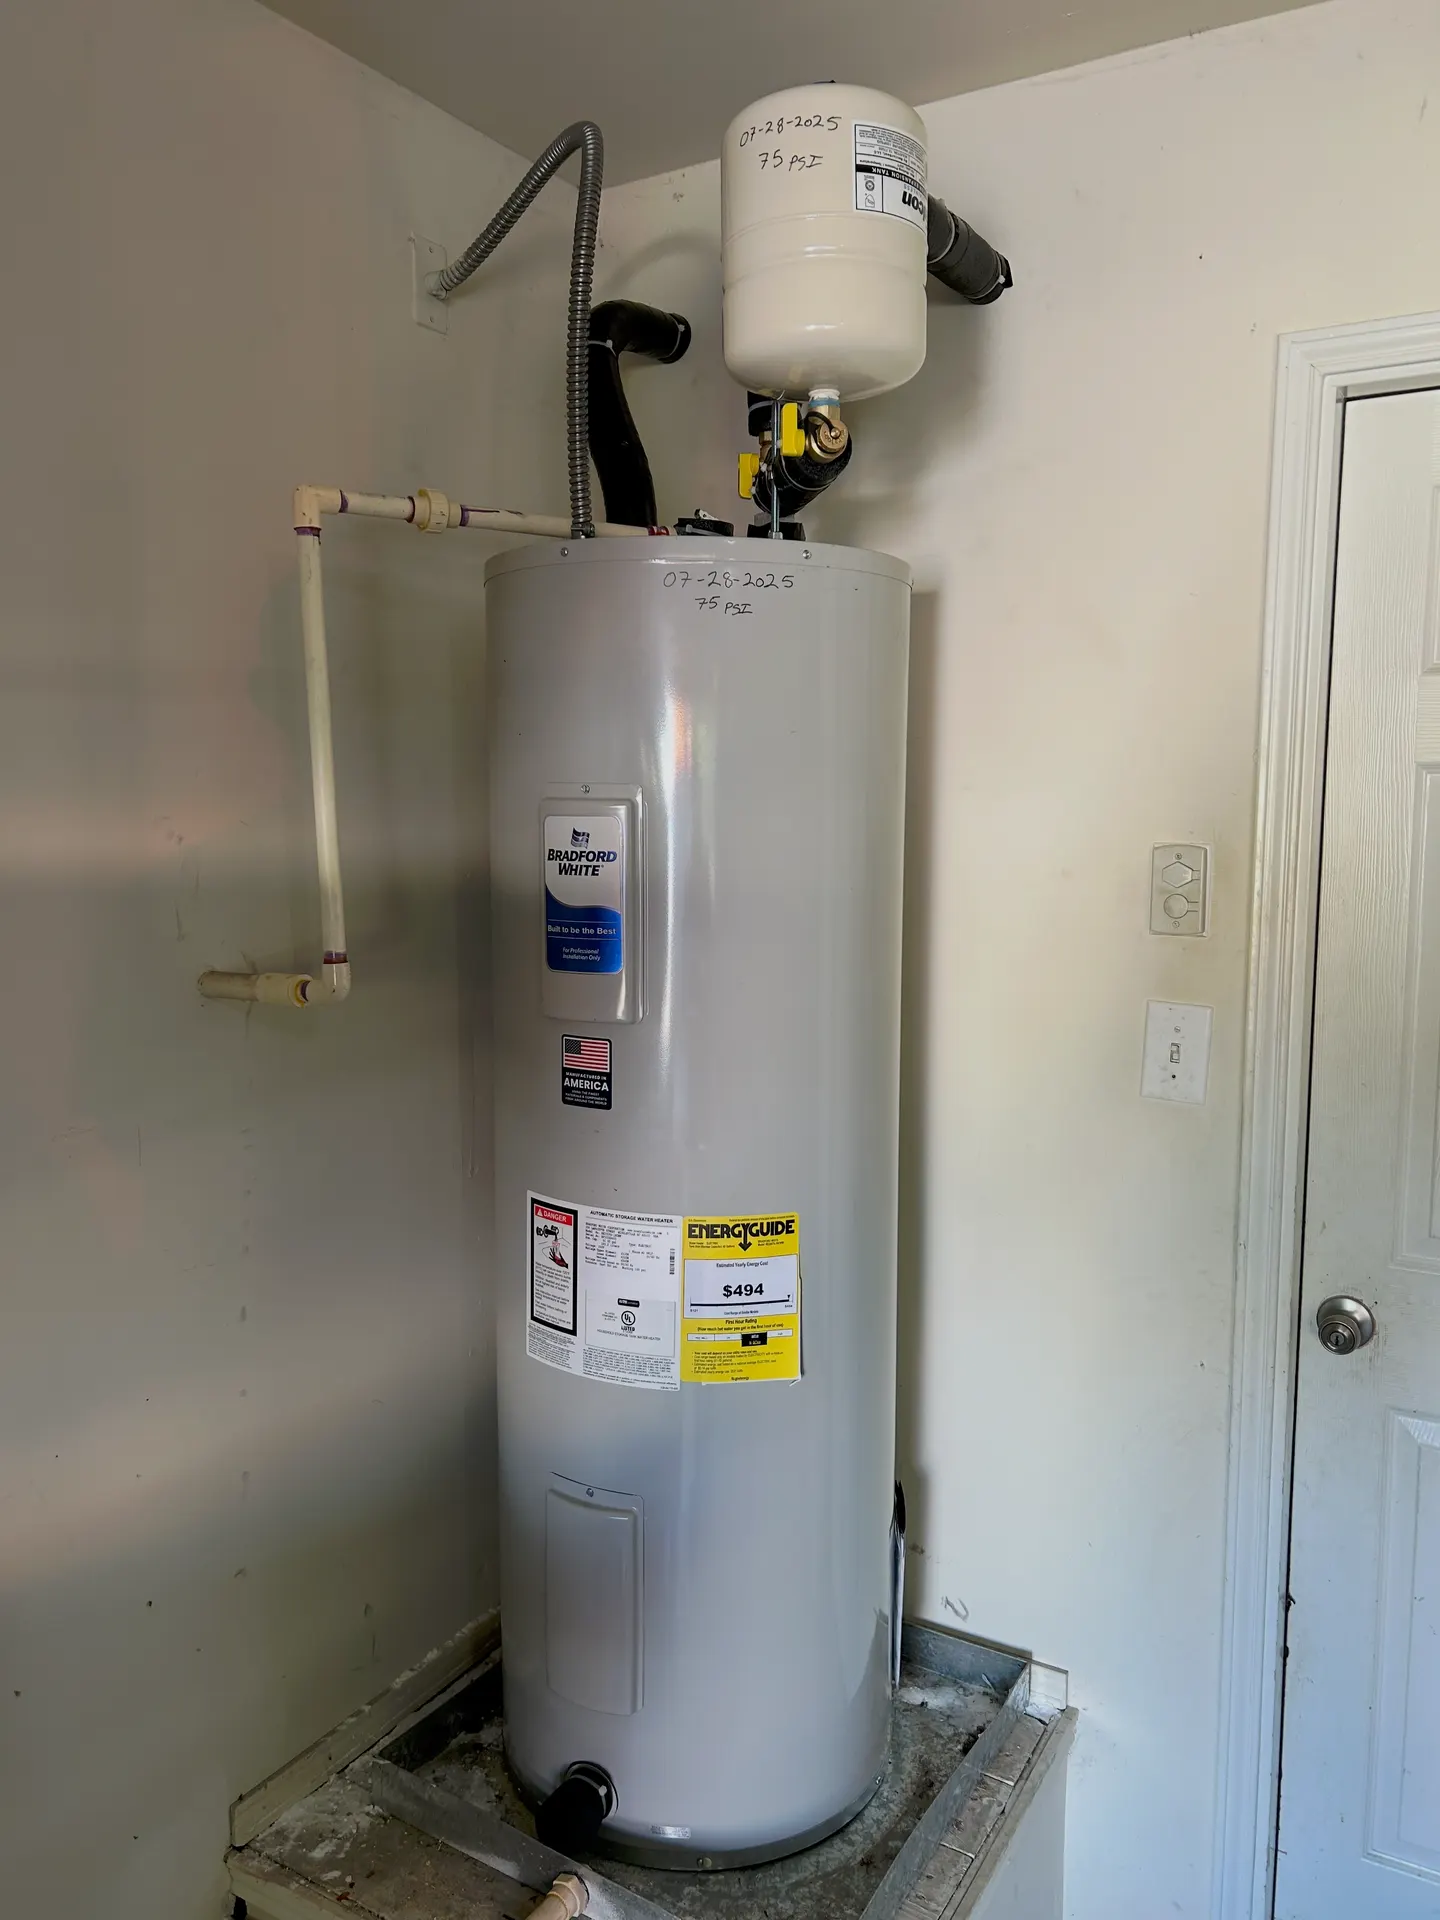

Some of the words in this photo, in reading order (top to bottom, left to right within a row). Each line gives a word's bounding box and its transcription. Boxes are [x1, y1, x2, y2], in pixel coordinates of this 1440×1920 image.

[740, 115, 842, 147] 07-28-2025
[759, 149, 783, 169] 75
[789, 154, 823, 171] PSI
[871, 167, 890, 176] TANK
[663, 571, 795, 589] 07-28-2025
[695, 596, 720, 610] 75
[724, 602, 753, 616] PSI
[547, 848, 618, 863] BRADFORD
[558, 863, 600, 876] WHITE
[547, 924, 561, 933] Built
[562, 925, 569, 933] to
[570, 926, 580, 934] be
[581, 926, 595, 935] the
[597, 927, 617, 935] Best
[570, 947, 600, 955] Professional
[588, 954, 601, 962] Only
[564, 1077, 609, 1091] AMERICA
[543, 1210, 567, 1222] DANGER
[590, 1210, 614, 1218] AUTOMATIC
[615, 1213, 636, 1221] STORAGE
[688, 1219, 795, 1239] ENERGYGUIDE
[722, 1283, 764, 1299] $494
[624, 1313, 632, 1323] UL
